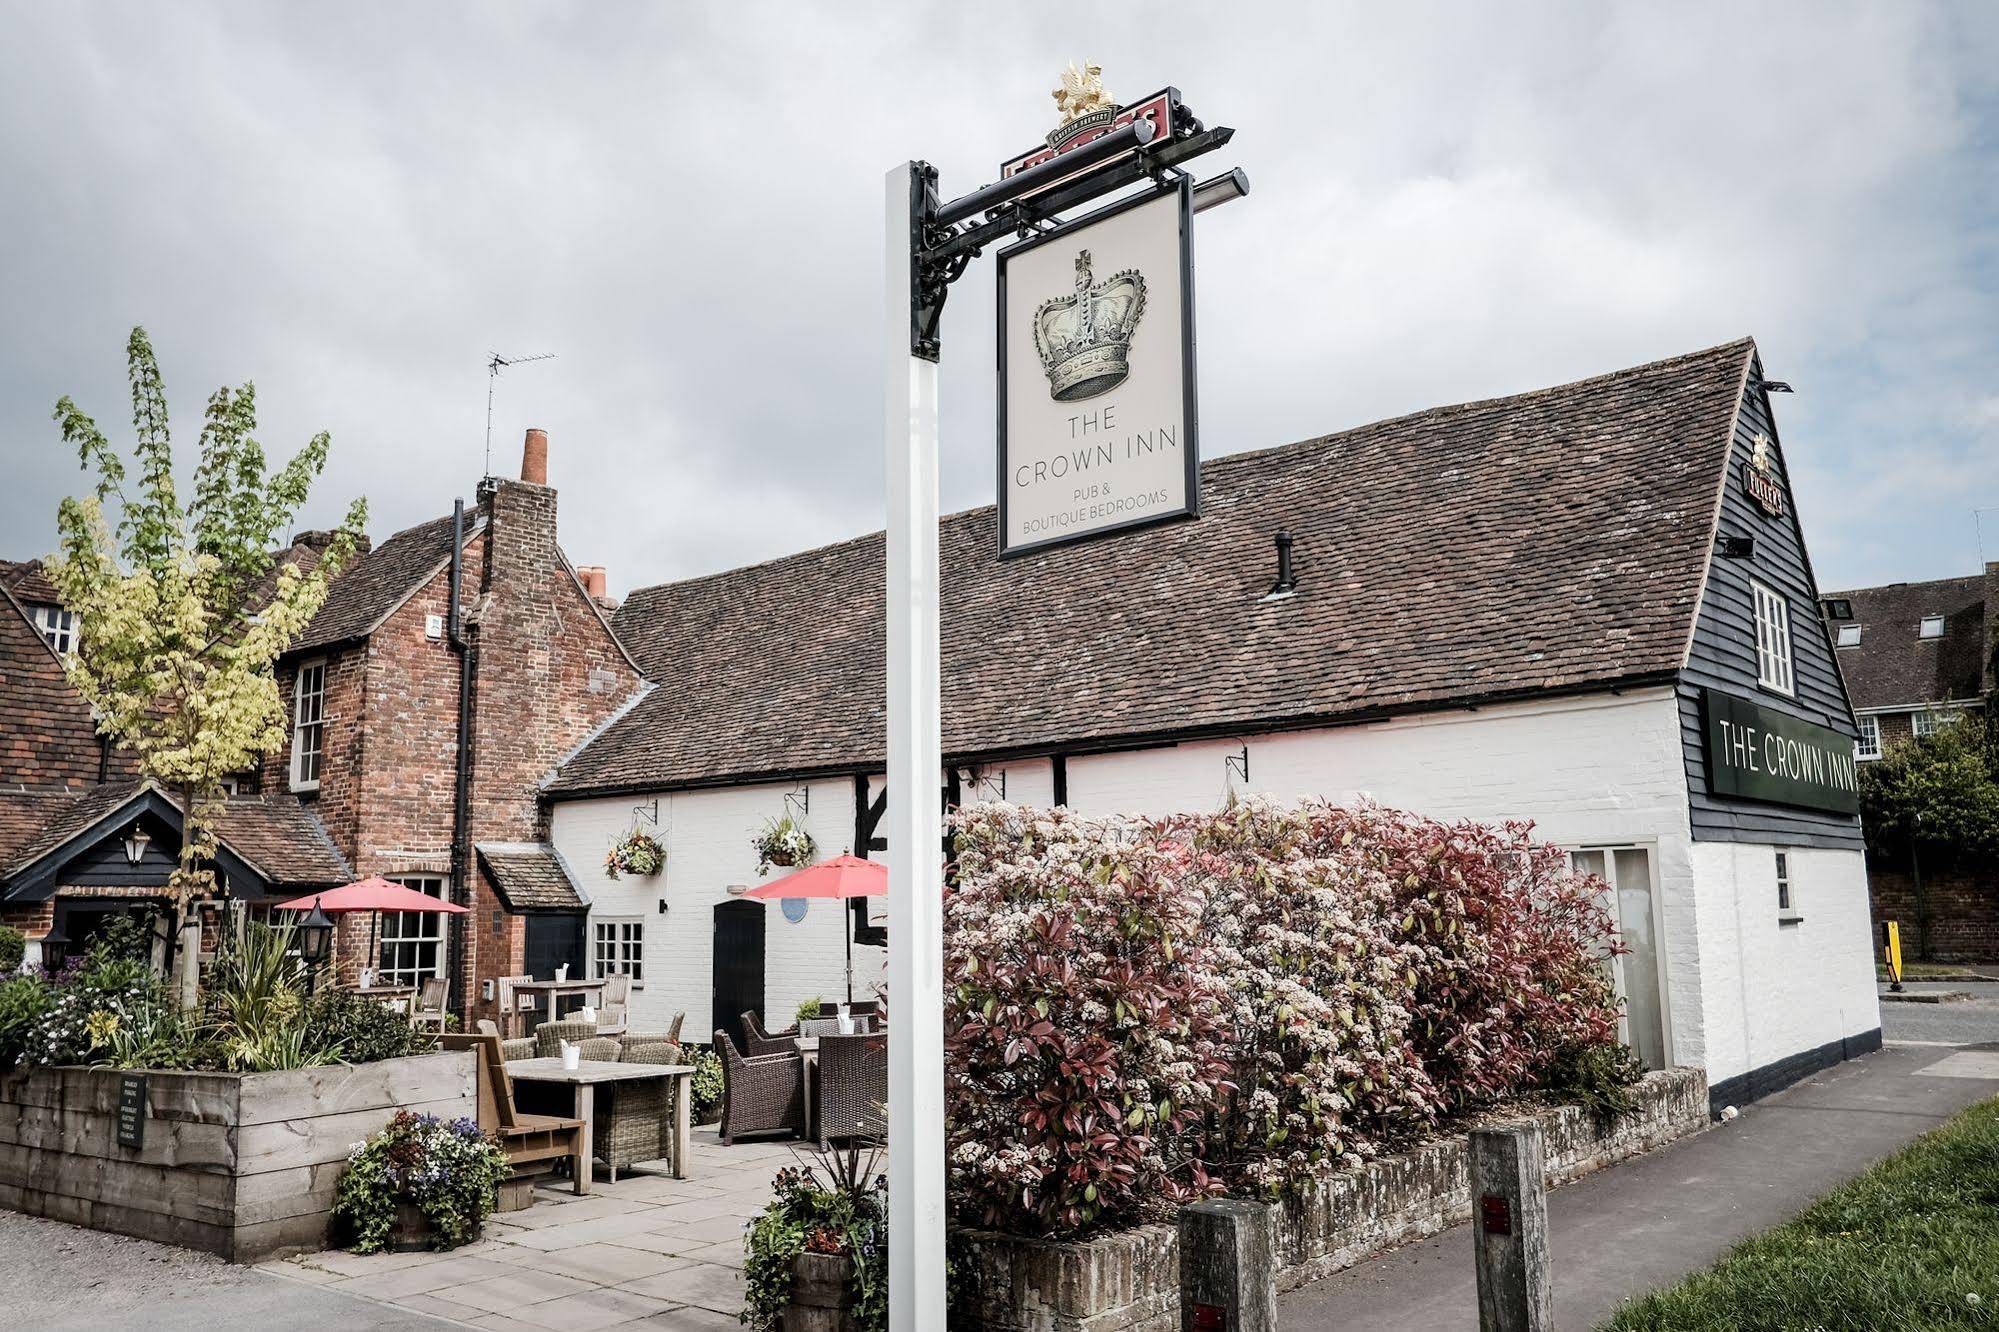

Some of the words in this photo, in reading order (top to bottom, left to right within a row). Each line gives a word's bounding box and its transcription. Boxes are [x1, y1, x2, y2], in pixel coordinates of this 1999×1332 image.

[1080, 113, 1108, 126] BREWERY
[1067, 405, 1116, 439] THE
[1016, 442, 1113, 488] CROWN
[1126, 424, 1177, 458] INN
[1023, 509, 1086, 535] BOUTIQUE
[1089, 489, 1168, 519] BEDROOMS
[1073, 484, 1099, 502] PUB
[1101, 482, 1111, 496] &
[1719, 720, 1759, 772] THE
[1764, 732, 1825, 786] CROWN
[1827, 751, 1854, 793] INN
